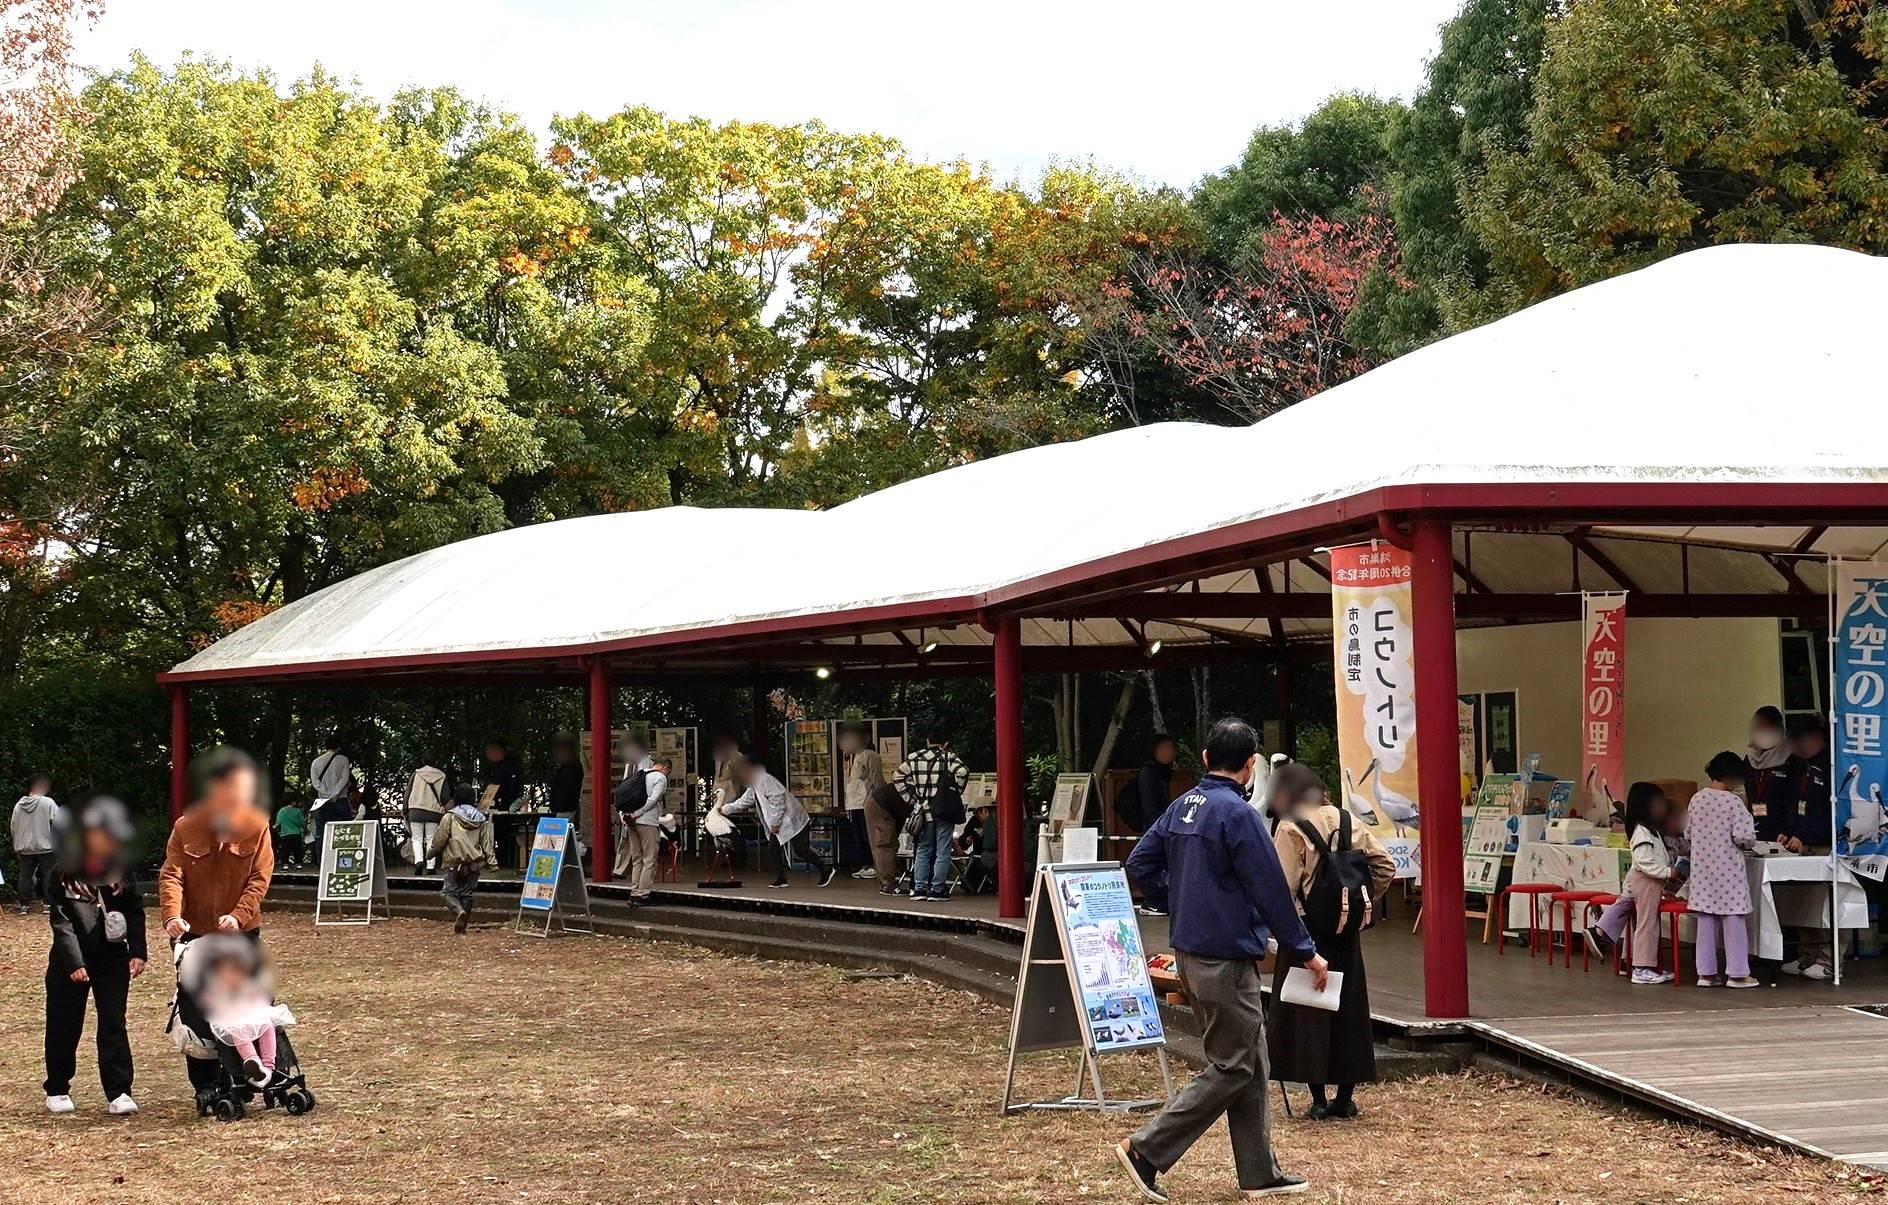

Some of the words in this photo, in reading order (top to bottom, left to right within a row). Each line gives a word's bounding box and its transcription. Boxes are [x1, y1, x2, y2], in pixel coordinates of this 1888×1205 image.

[1587, 609, 1617, 756] 天空の里
[1842, 577, 1888, 756] 天空の里
